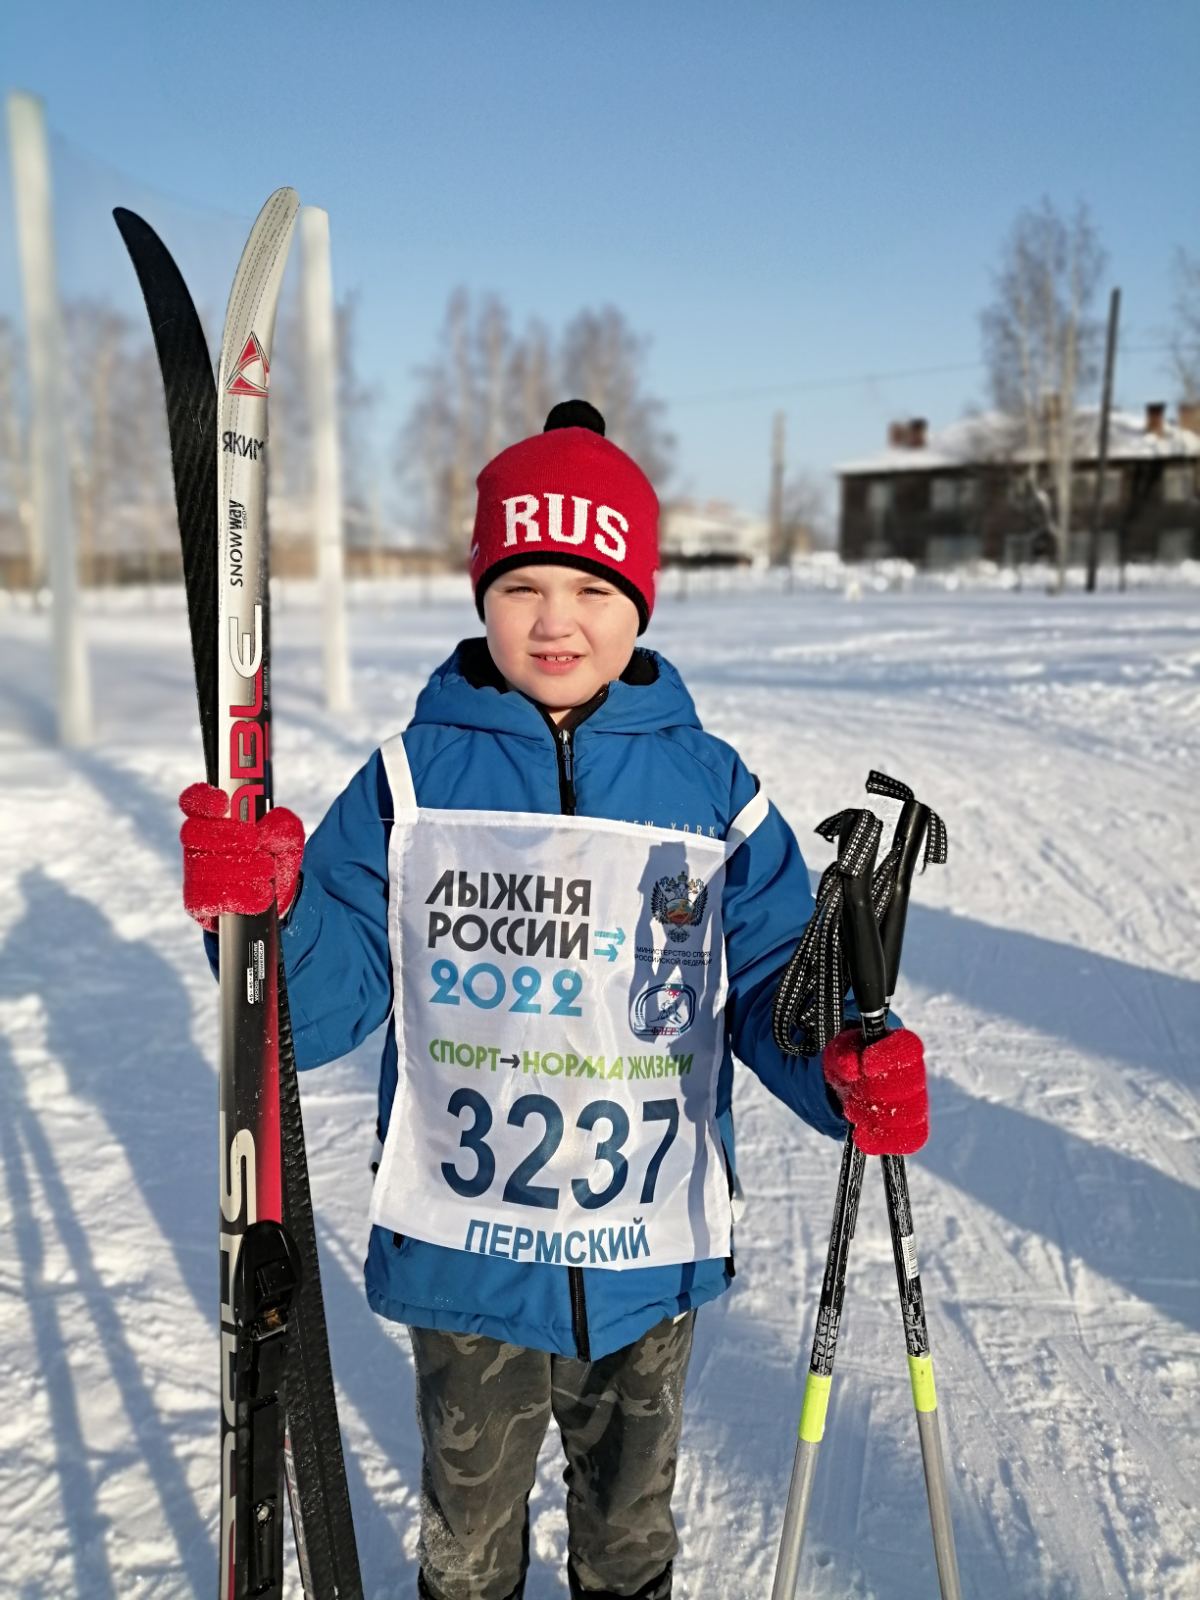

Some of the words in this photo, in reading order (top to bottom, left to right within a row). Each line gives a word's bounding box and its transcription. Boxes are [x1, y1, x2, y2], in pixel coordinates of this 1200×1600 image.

[222, 431, 264, 461] ЯКИМ
[502, 492, 629, 562] RUS
[228, 603, 264, 824] ABLE
[424, 869, 592, 917] ЛЫЖНЯ
[428, 911, 590, 961] РОССИИ
[428, 958, 584, 1017] 2022
[429, 1039, 501, 1072] СПОРТ
[523, 1050, 623, 1080] НОРМА
[627, 1053, 693, 1080] ЖИЗНИ
[440, 1087, 680, 1210] 3237
[464, 1217, 651, 1265] ПЕРМСКИЙ
